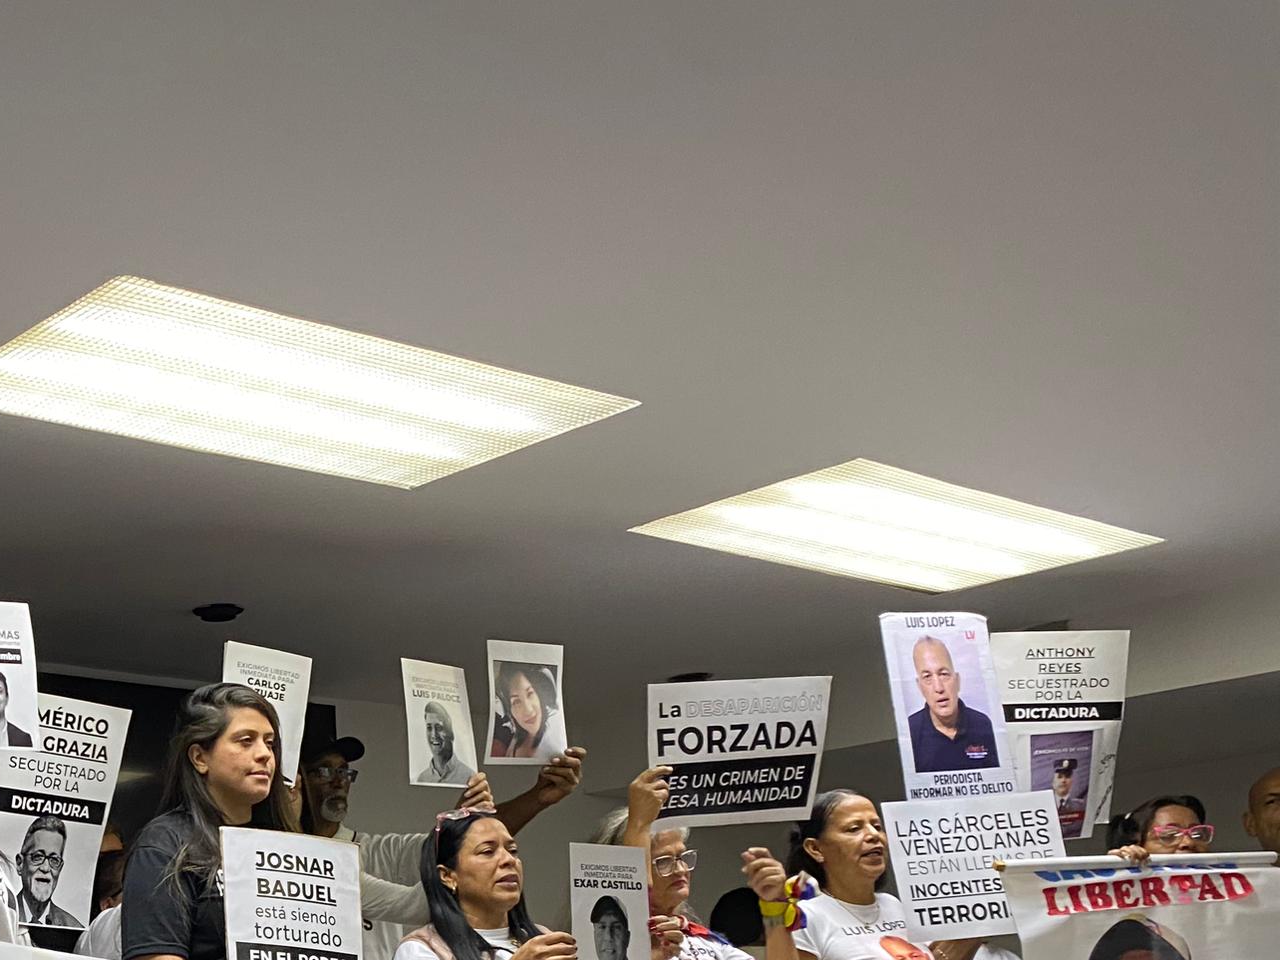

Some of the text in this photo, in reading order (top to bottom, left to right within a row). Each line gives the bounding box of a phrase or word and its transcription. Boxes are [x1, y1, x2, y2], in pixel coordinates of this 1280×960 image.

[905, 616, 955, 627] LUIS LOPEZ
[1026, 647, 1095, 658] ANTHONY
[1039, 663, 1081, 672] REYES
[248, 678, 286, 691] CARLOS
[1008, 678, 1109, 689] SECUESTRADO
[412, 690, 430, 698] LUIS
[659, 691, 822, 718] La DESAPARICIÓN
[1014, 707, 1099, 719] DICTADURA
[43, 736, 108, 760] GRAZIA
[657, 720, 817, 757] FORZADA
[35, 776, 79, 793] POR LA
[703, 785, 802, 806] HUMANIDAD
[11, 795, 89, 819] DICTADURA
[896, 809, 1048, 837] LAS CÁRCELES
[256, 851, 334, 876] JOSNAR
[257, 878, 336, 903] BADUEL
[574, 879, 642, 890] EXAR CASTILLO
[910, 878, 1002, 899] INOCENTES
[1042, 872, 1255, 915] LIBERTAD
[256, 906, 336, 926] está siendo
[255, 923, 342, 947] torturado
[842, 923, 875, 936] LUIS
